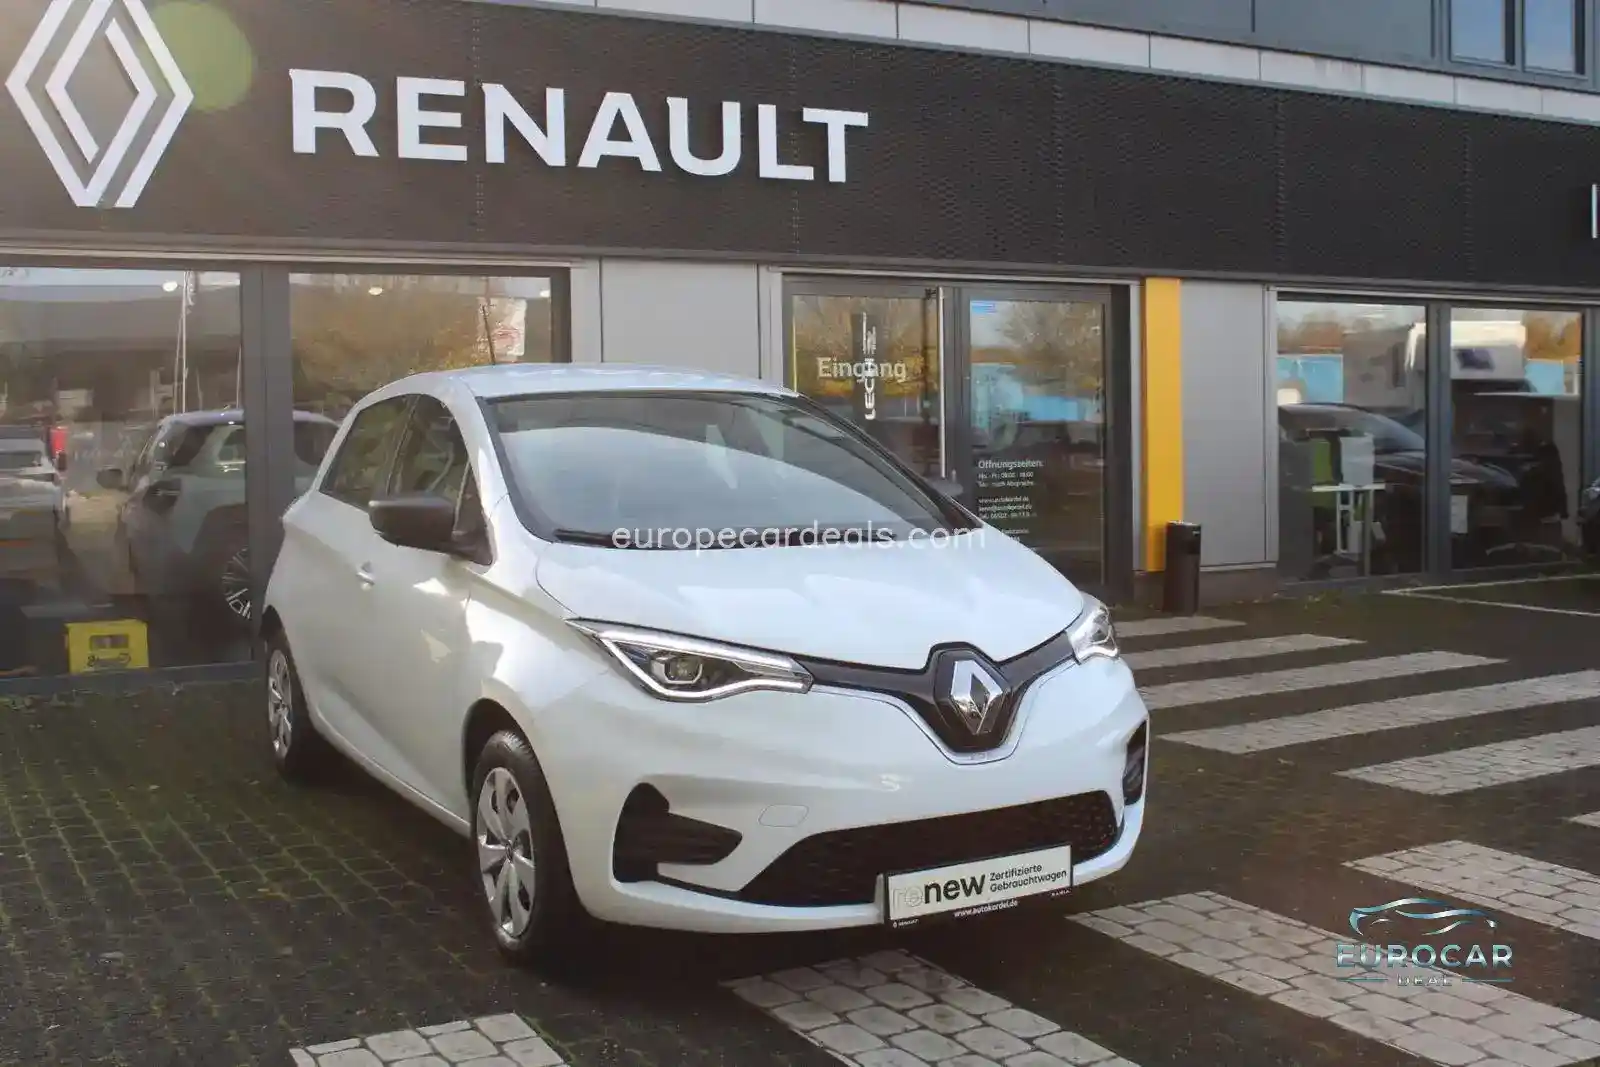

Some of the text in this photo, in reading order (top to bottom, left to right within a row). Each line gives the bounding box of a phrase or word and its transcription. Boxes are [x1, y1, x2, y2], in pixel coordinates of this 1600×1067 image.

[289, 68, 868, 182] RENAULT
[817, 357, 906, 383] Eingang
[989, 864, 1042, 882] Zertifizierte
[989, 869, 1067, 893] Gebrauchtwagen
